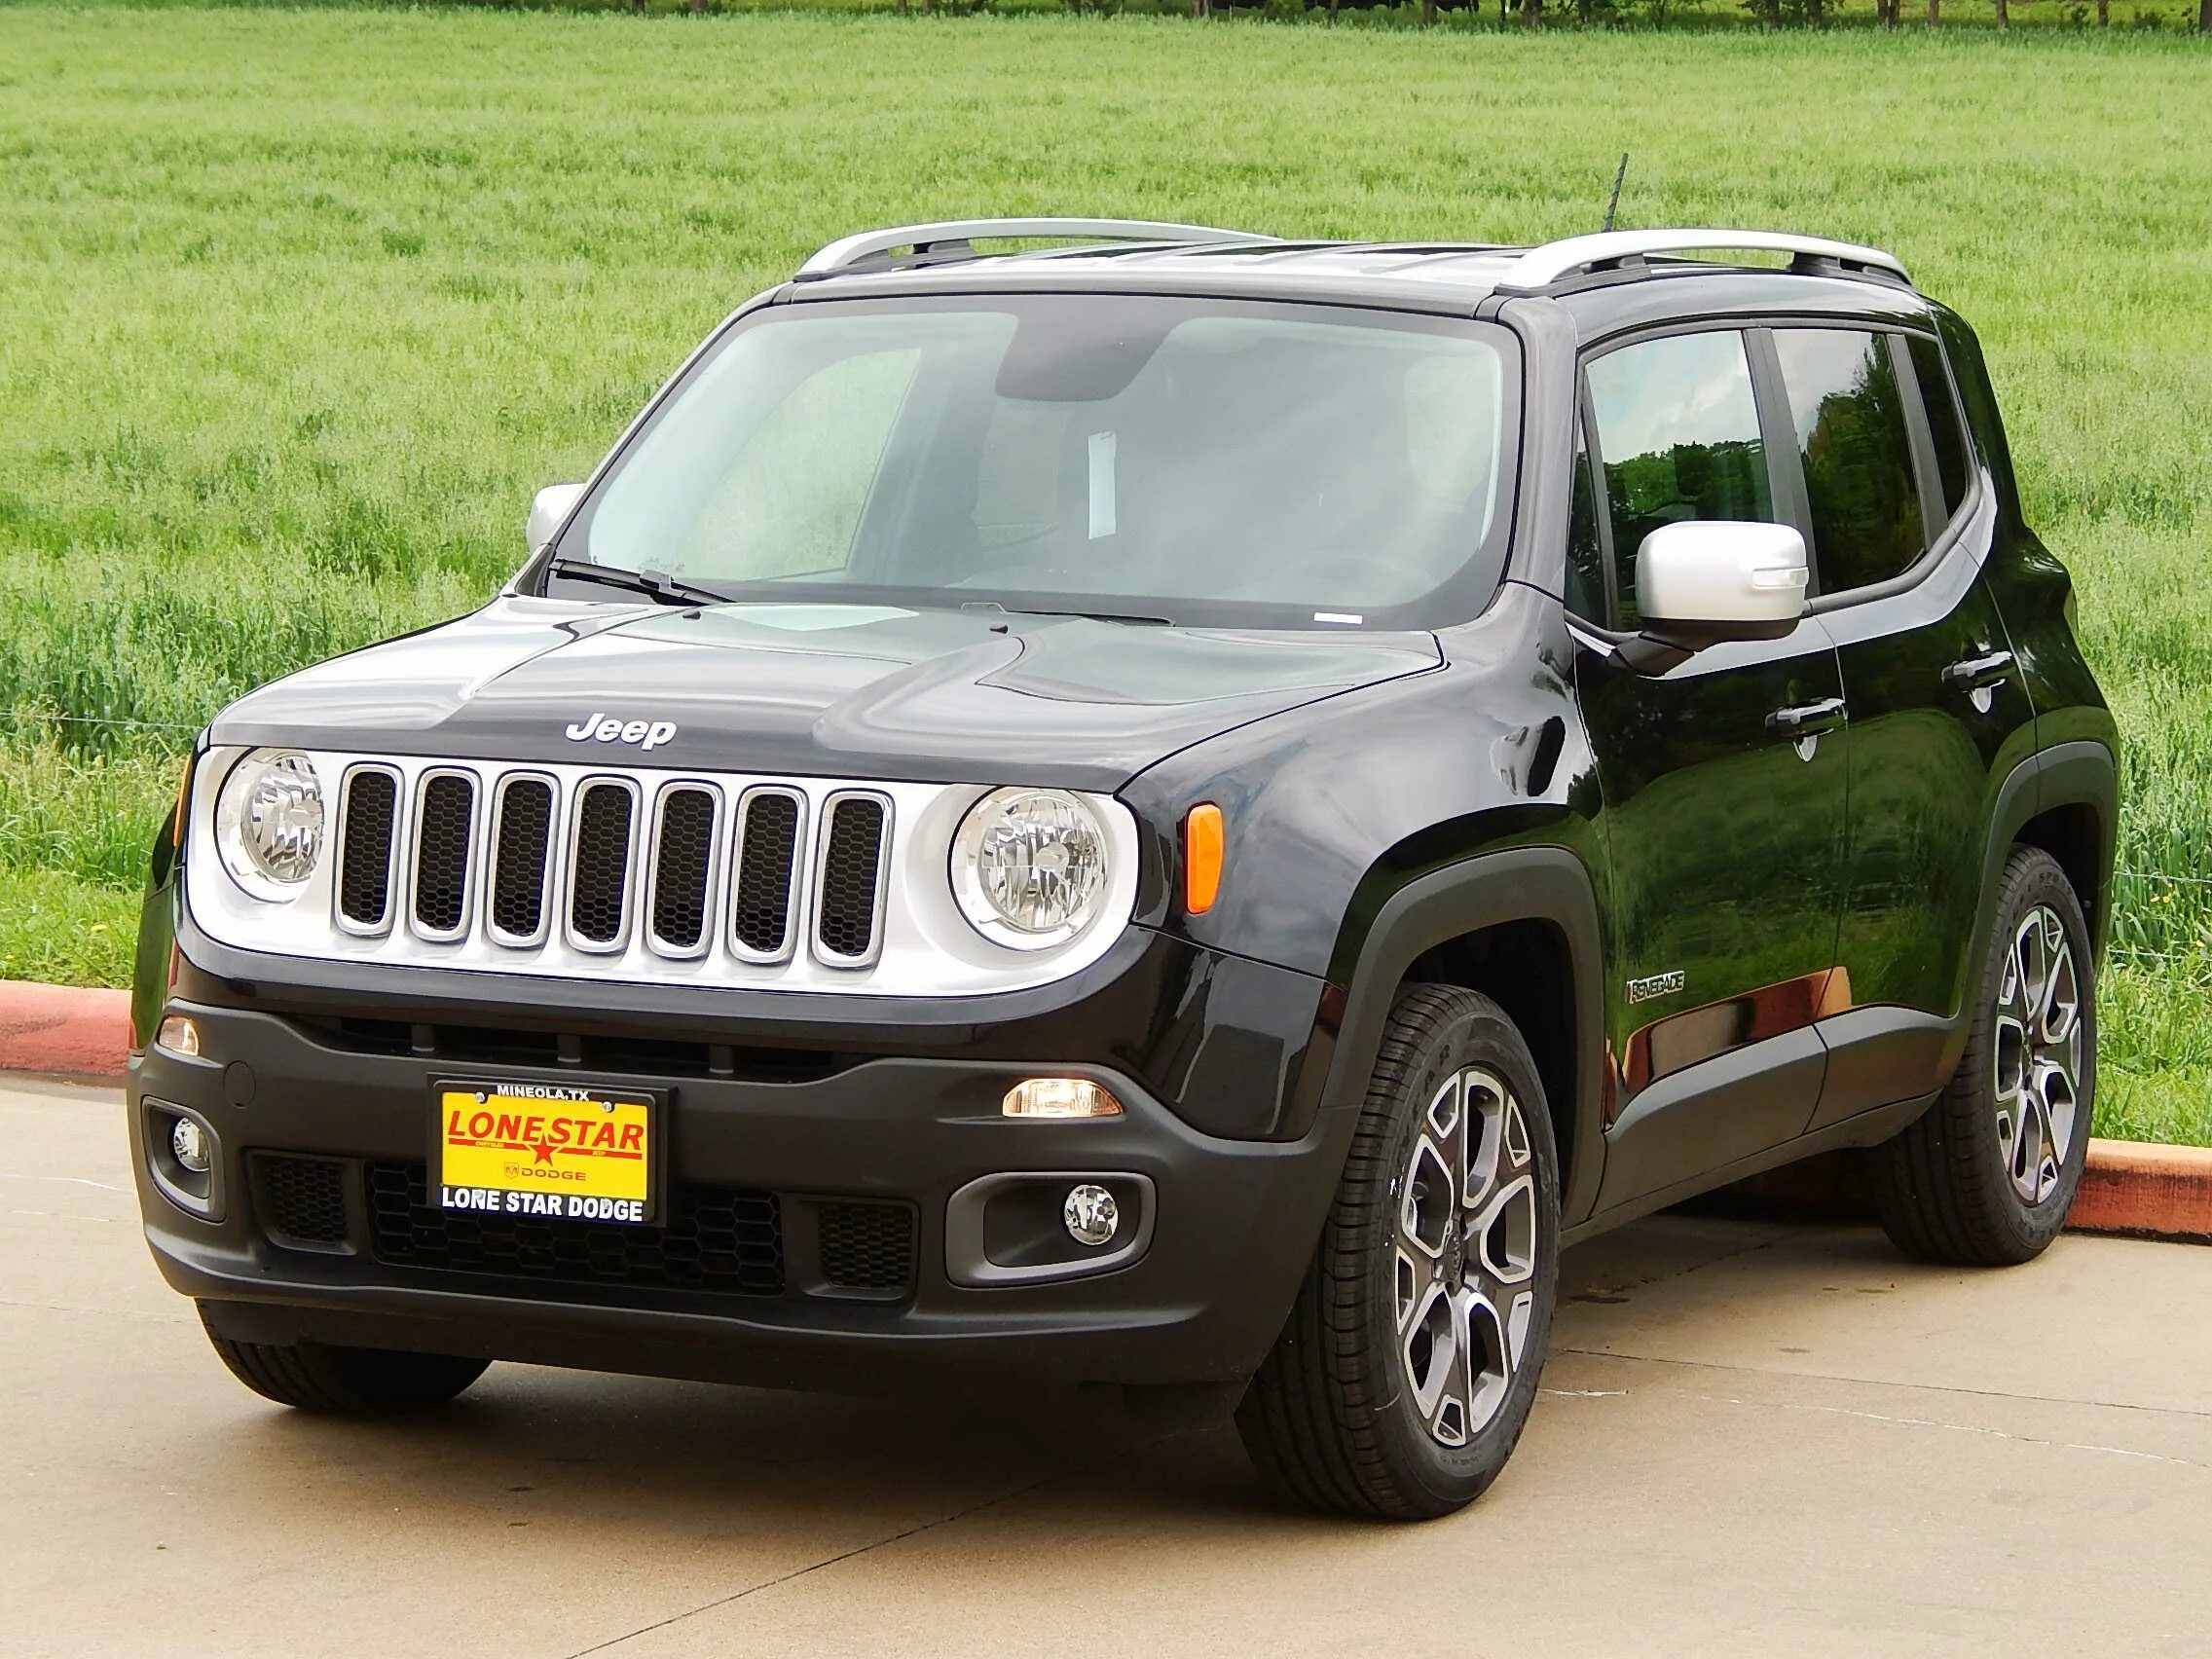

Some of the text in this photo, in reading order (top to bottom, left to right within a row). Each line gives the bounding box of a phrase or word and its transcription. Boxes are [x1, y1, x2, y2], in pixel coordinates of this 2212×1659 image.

[566, 713, 677, 751] Jeep
[1626, 970, 1685, 1004] RENEGADE
[521, 1167, 586, 1181] DODGE
[442, 1187, 643, 1222] LONE STAR DODGE
